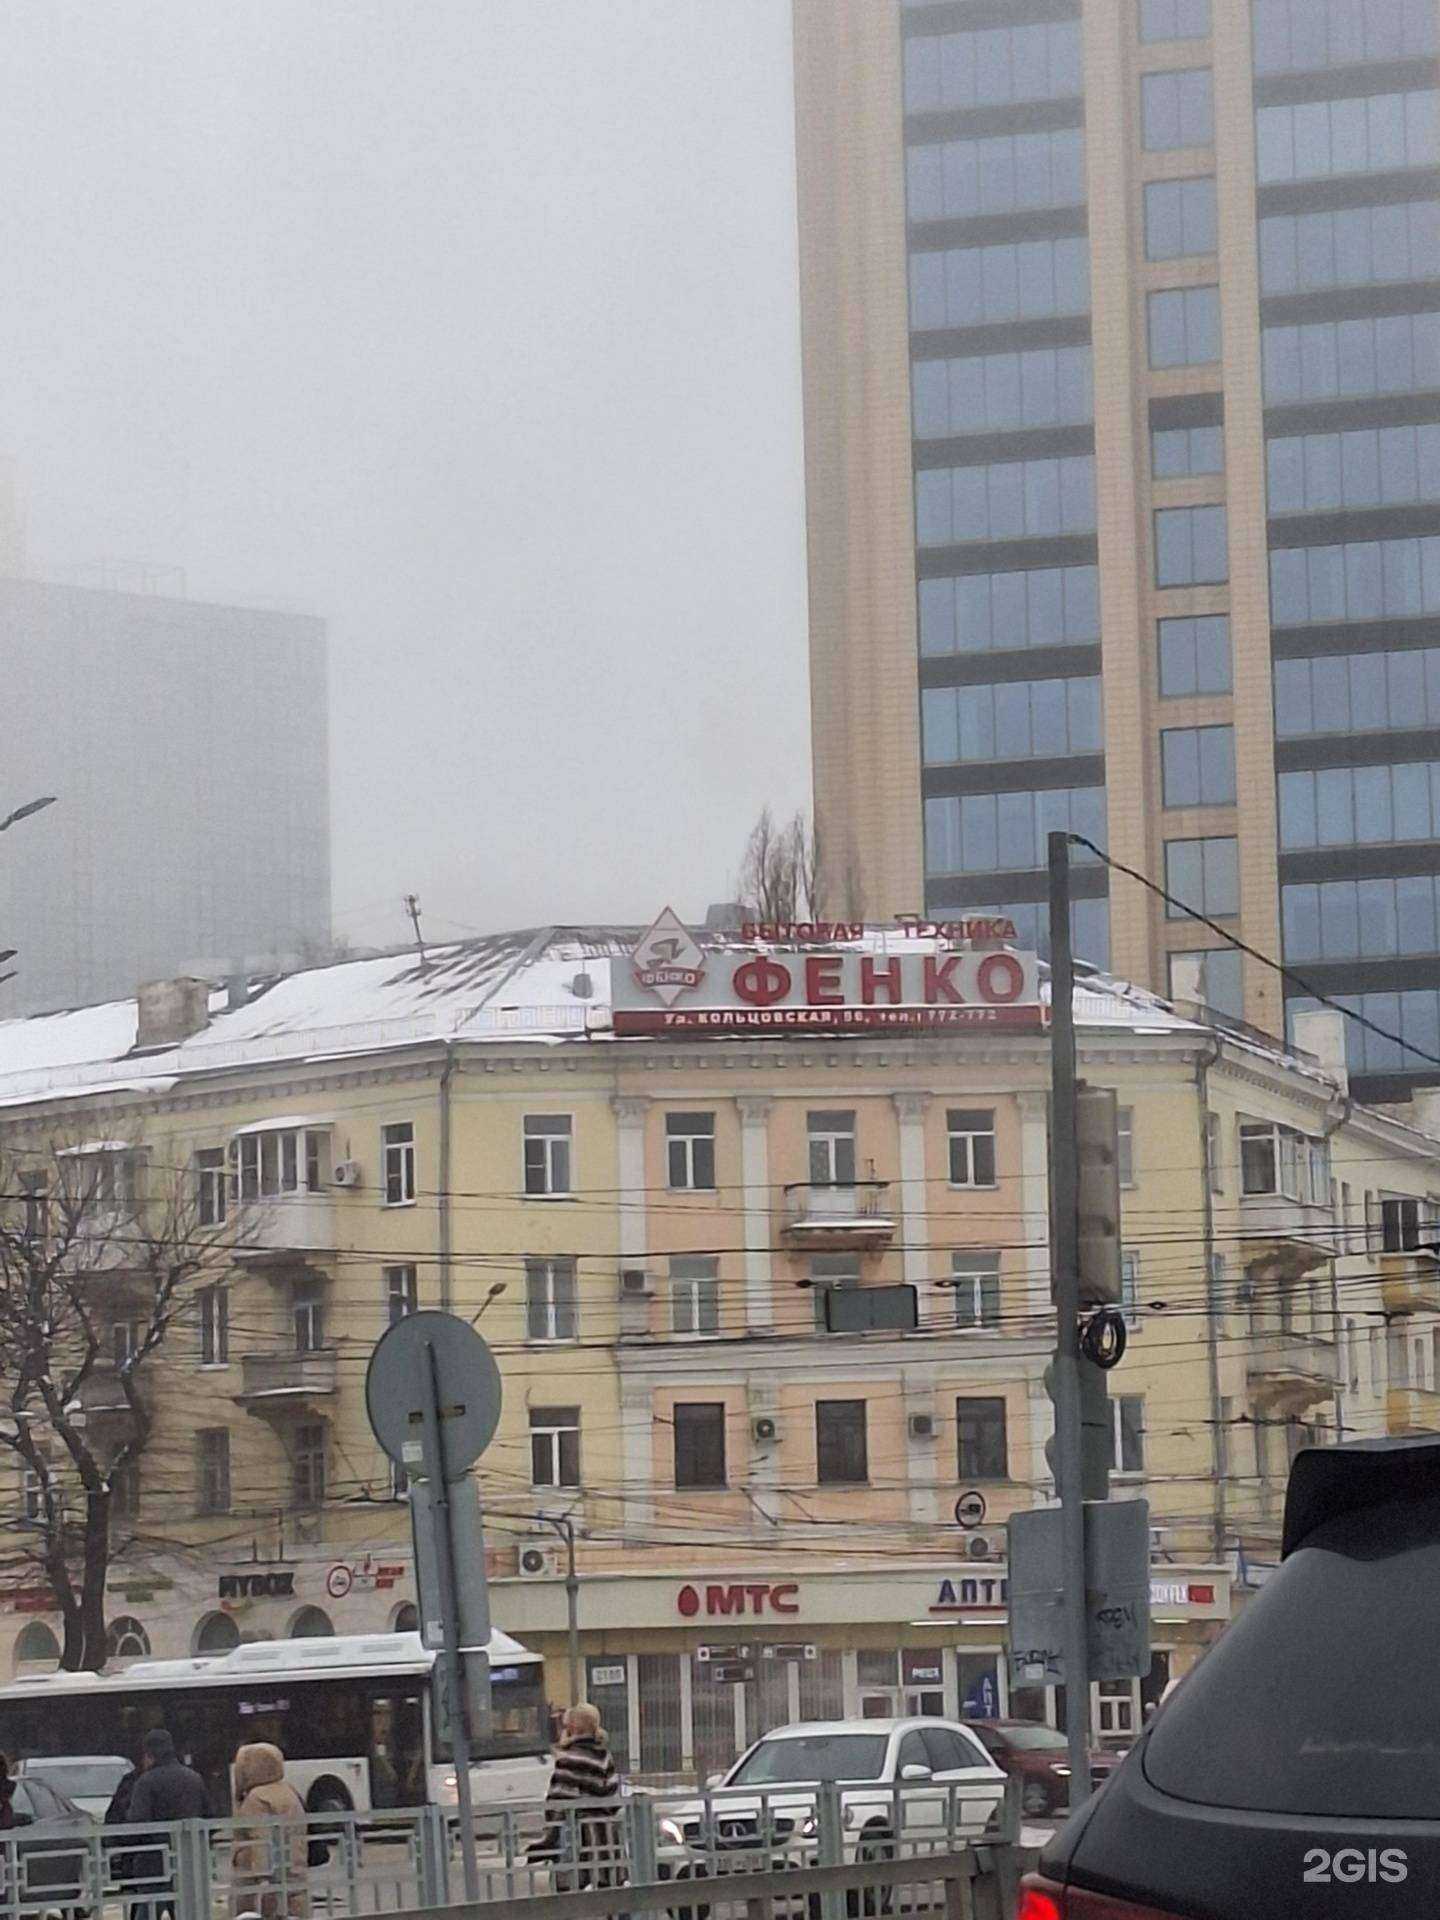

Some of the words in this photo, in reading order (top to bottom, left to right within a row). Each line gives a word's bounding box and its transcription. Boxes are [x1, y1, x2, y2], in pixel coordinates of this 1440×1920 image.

[742, 923, 864, 940] БЫТОВАЯ
[902, 919, 1018, 939] ТЕХНИКА
[733, 954, 1024, 1006] ФЕНКО
[706, 1584, 800, 1615] МТС
